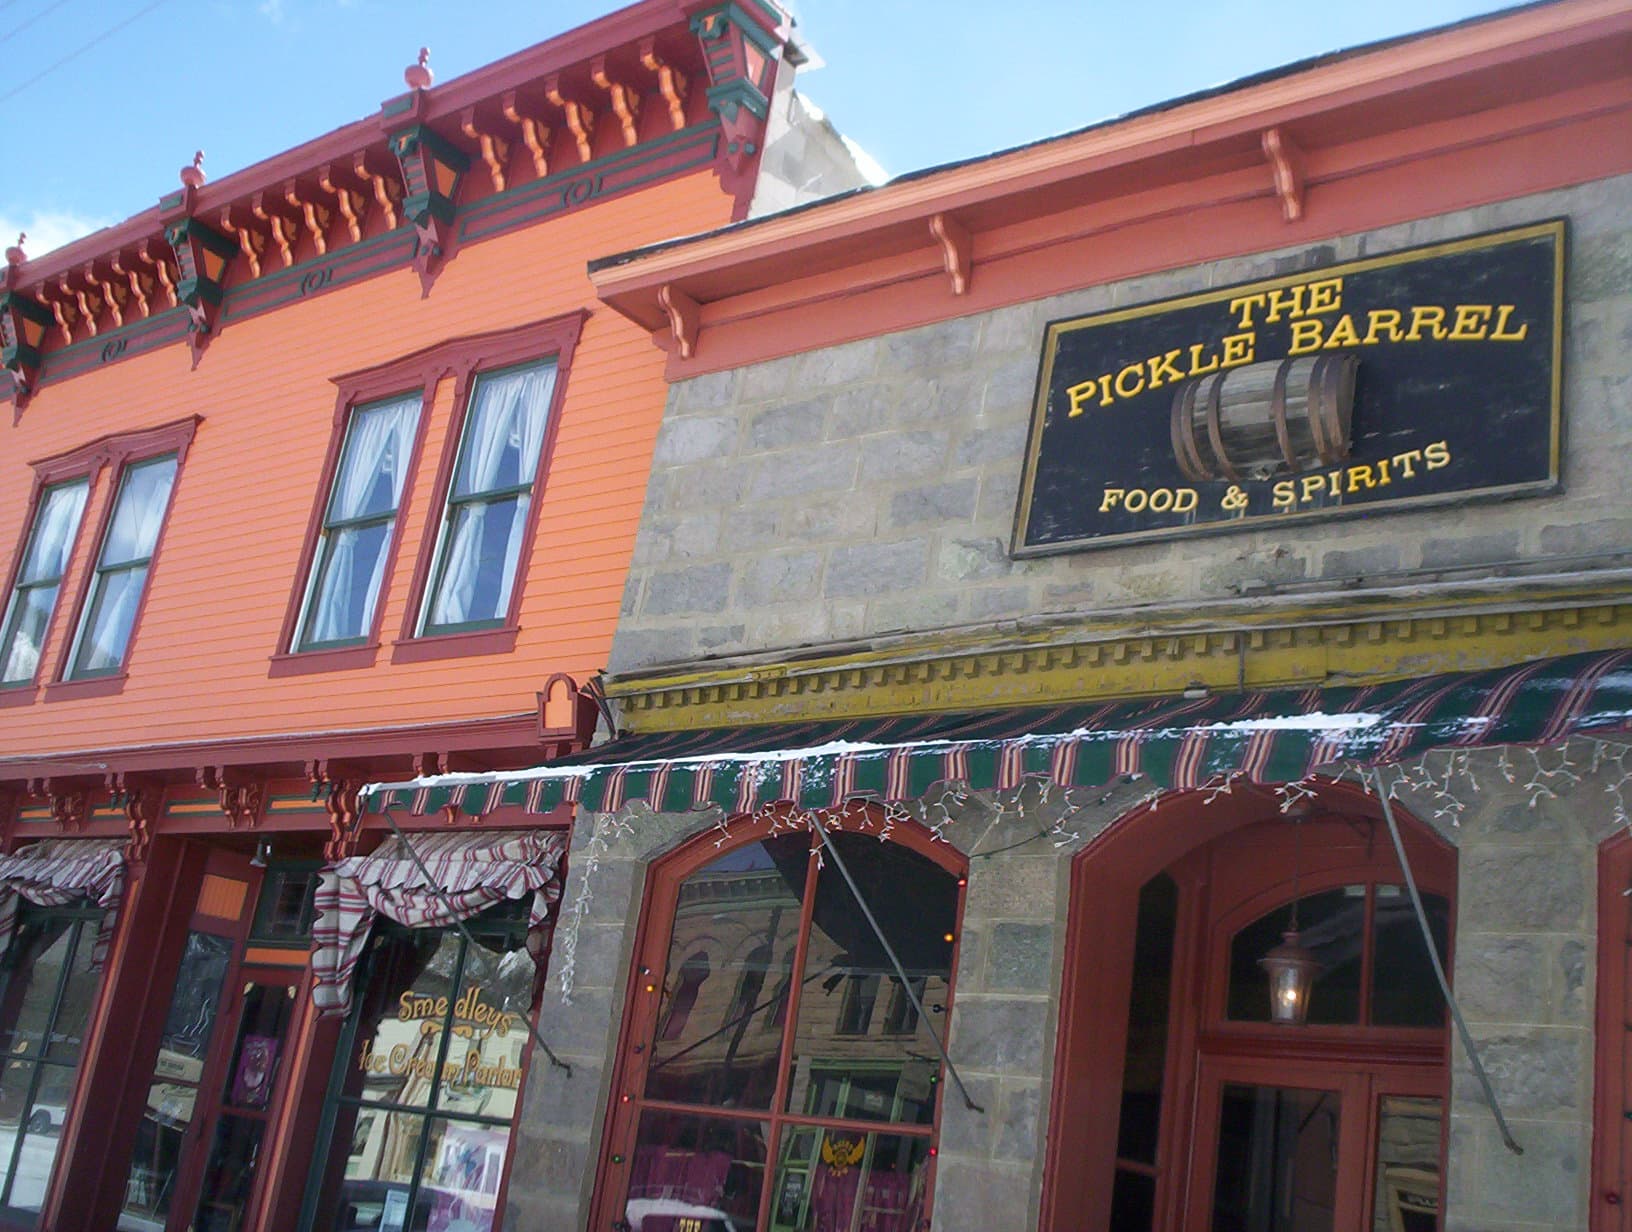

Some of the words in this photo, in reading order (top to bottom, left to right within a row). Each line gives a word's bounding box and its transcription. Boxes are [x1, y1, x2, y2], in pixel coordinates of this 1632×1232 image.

[1229, 278, 1344, 329] THE
[1065, 332, 1257, 419] PICKLE
[1287, 304, 1529, 355] BARREL
[1098, 487, 1199, 514] FOOD
[1220, 485, 1249, 510] &
[1271, 440, 1452, 507] SPIRITS
[398, 986, 515, 1041] Smedleys
[358, 1039, 388, 1073] Ice
[463, 1049, 523, 1088] Parlor
